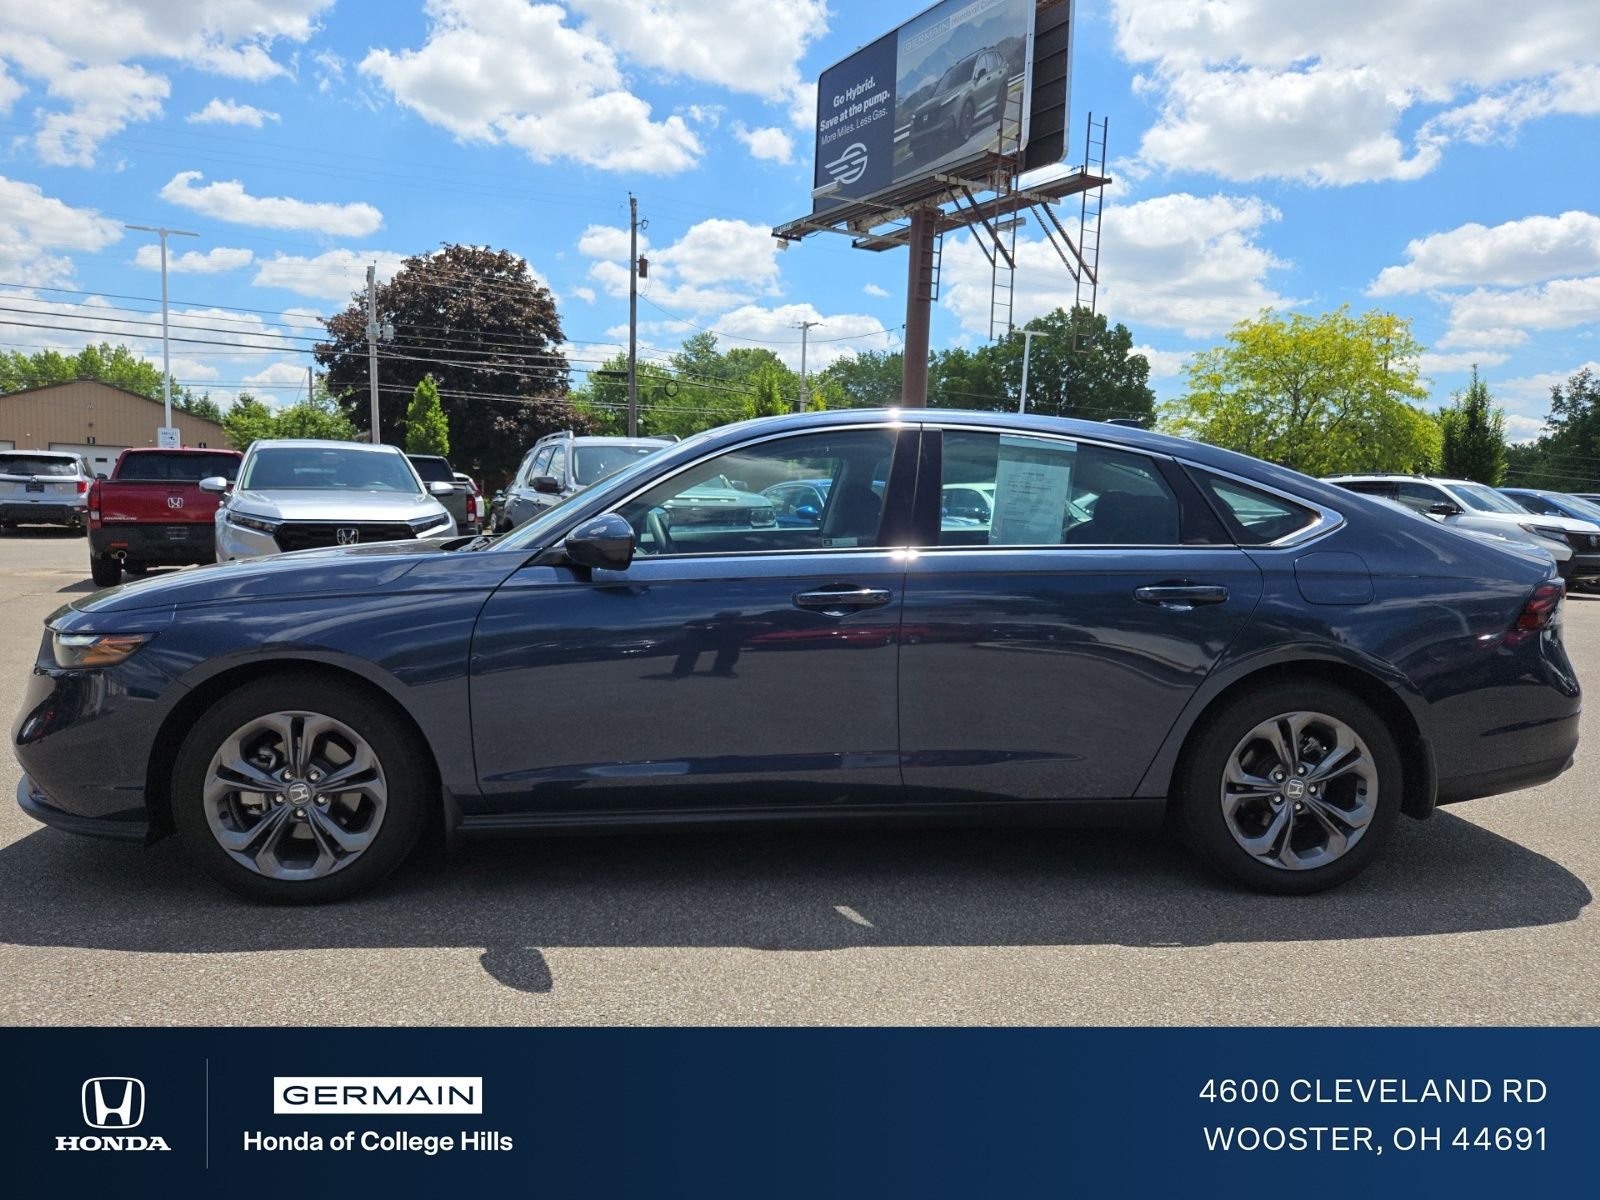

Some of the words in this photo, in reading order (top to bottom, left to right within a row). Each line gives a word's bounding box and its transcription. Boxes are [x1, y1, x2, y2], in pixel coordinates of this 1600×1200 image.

[833, 95, 845, 108] Go
[845, 76, 876, 102] Hybrid.
[820, 116, 839, 132] Save
[839, 109, 848, 122] at
[849, 104, 862, 117] the
[863, 90, 890, 112] pump.
[821, 133, 837, 145] More
[837, 124, 855, 138] Miles.
[856, 115, 872, 129] Less
[872, 108, 888, 121] Gas.
